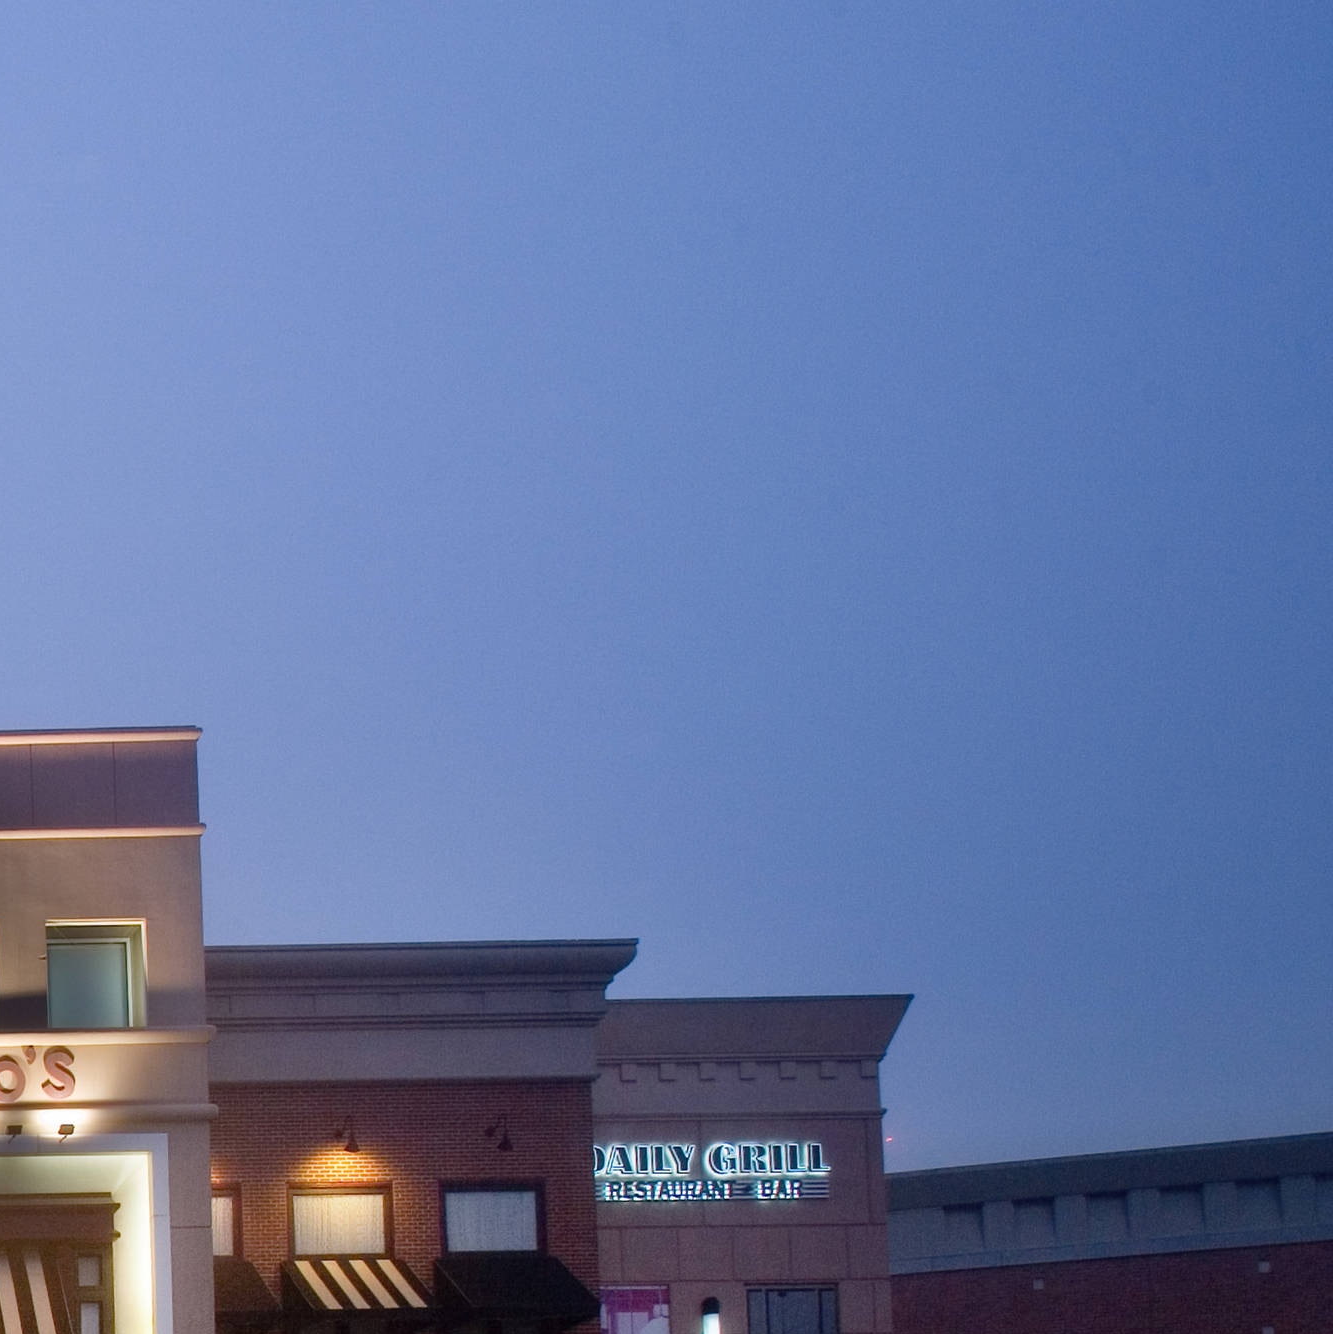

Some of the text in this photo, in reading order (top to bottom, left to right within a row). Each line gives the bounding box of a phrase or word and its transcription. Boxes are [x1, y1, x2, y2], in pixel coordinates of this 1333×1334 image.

[593, 1141, 832, 1176] DAILY GRILL
[604, 1179, 802, 1202] RESTAURANT BAR
